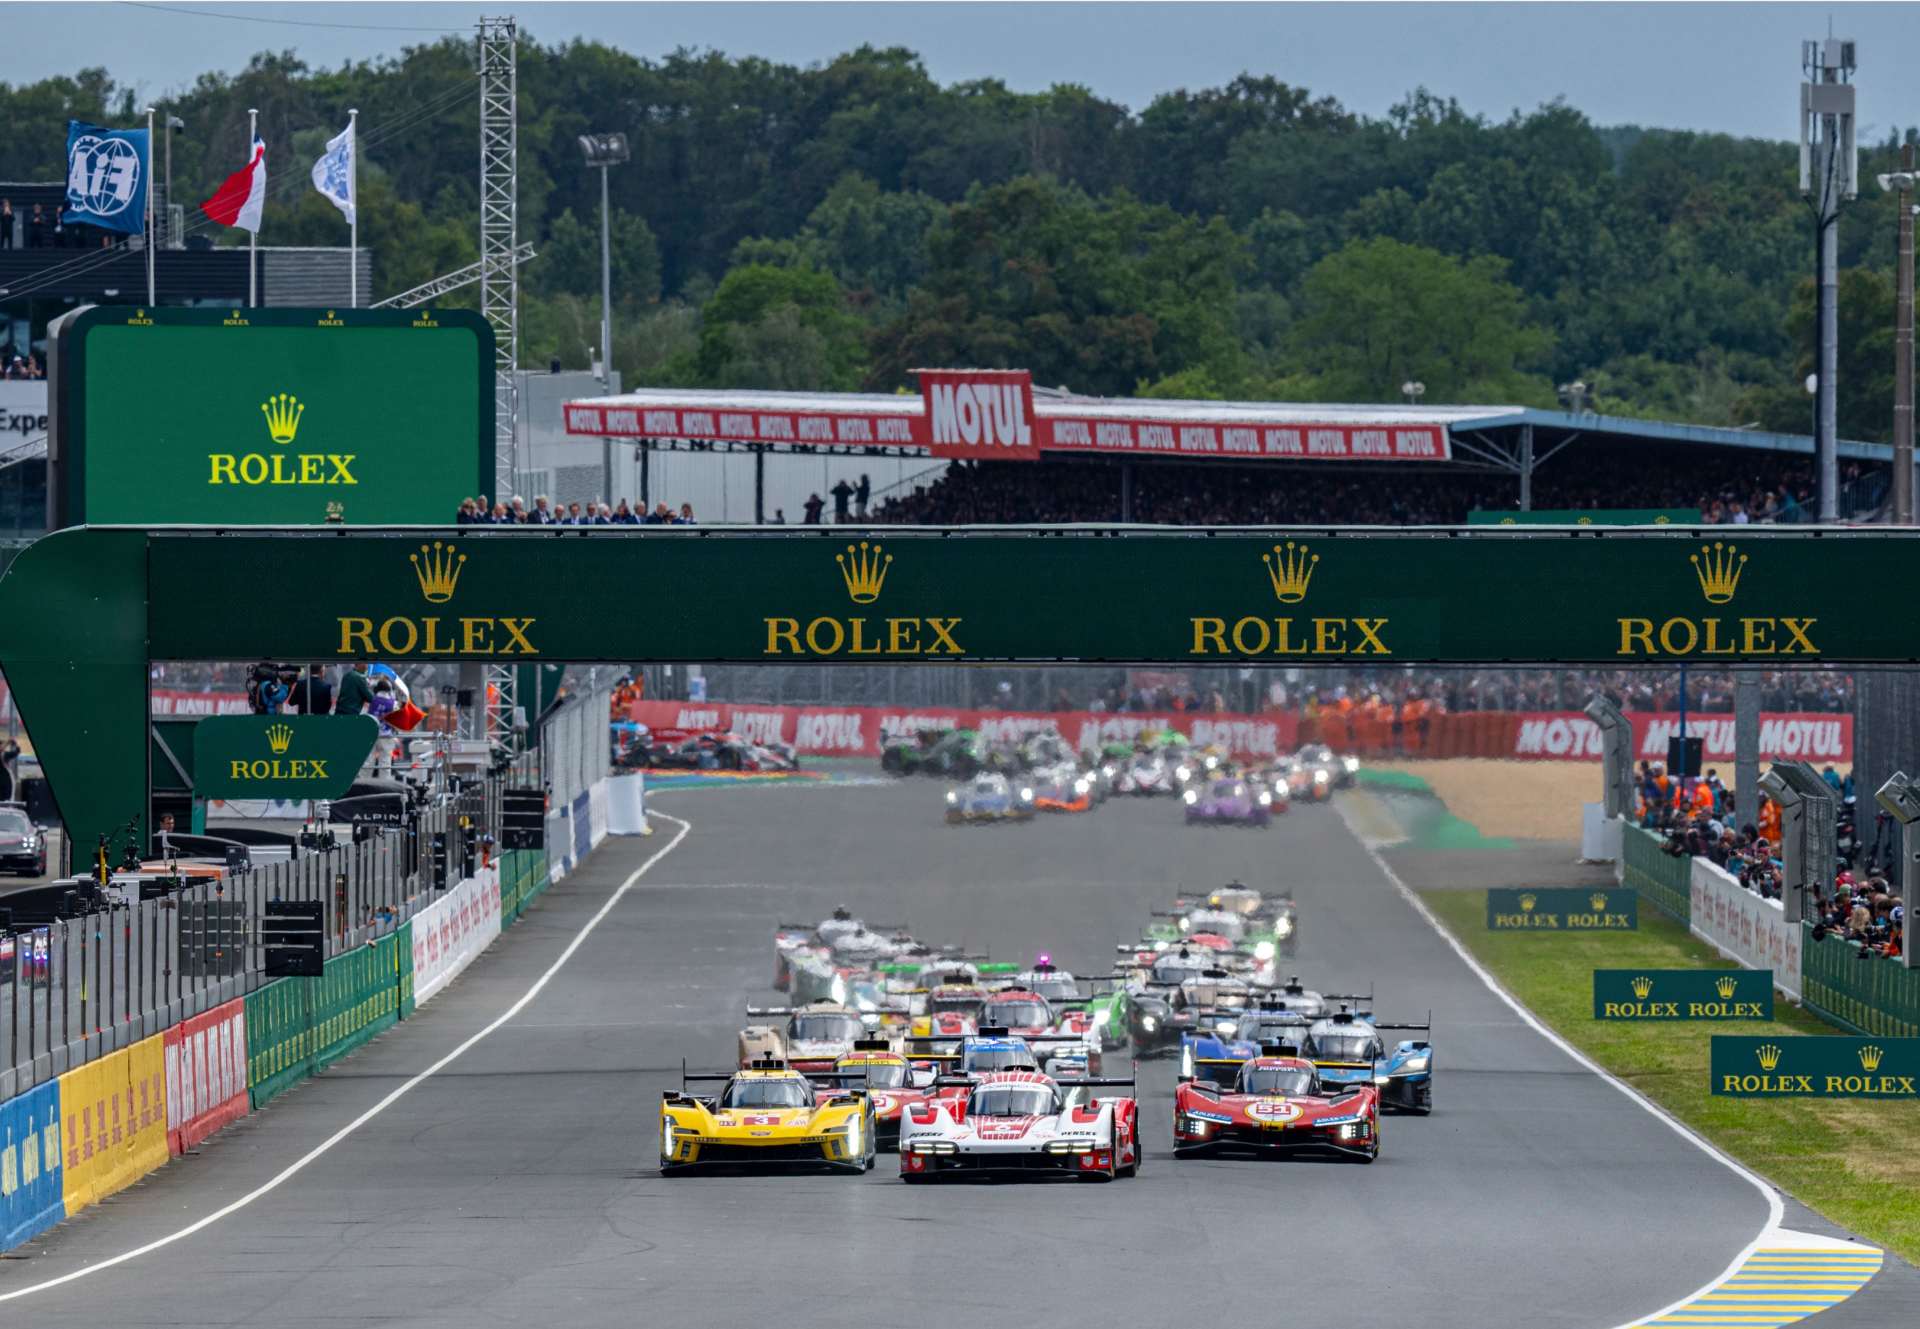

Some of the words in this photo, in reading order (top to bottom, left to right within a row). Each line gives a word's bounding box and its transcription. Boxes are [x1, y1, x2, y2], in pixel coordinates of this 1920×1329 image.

[127, 317, 153, 326] ROLEX
[223, 318, 249, 327] ROLEX
[318, 319, 344, 327] ROLEX
[413, 320, 438, 328] ROLEX
[569, 408, 602, 432] MOTUL
[606, 409, 641, 433] MOTUL
[643, 410, 679, 434] MOTUL
[682, 411, 716, 435] MOTUL
[719, 412, 755, 436] MOTUL
[759, 414, 794, 439] MOTUL
[798, 416, 833, 440] MOTUL
[837, 417, 873, 441] MOTUL
[876, 418, 913, 442] MOTUL
[931, 383, 1032, 447] MOTUL
[1053, 420, 1092, 446] MOTUL
[1095, 422, 1134, 448] MOTUL
[1137, 424, 1175, 449] MOTUL
[1179, 426, 1218, 451] MOTUL
[1222, 428, 1260, 452] MOTUL
[1264, 429, 1303, 454] MOTUL
[1307, 430, 1347, 454] MOTUL
[1351, 430, 1392, 455] MOTUL
[1395, 431, 1436, 455] MOTUL
[208, 453, 358, 485] ROLEX
[336, 616, 539, 655] ROLEX
[763, 616, 965, 655] ROLEX
[1189, 616, 1391, 655] ROLEX
[1616, 616, 1821, 655] ROLEX
[795, 713, 865, 749] MOTUL
[1515, 718, 1604, 755] MOTU
[1759, 719, 1842, 756] MOTUL
[229, 759, 329, 780] ROLEX
[1495, 914, 1558, 928] ROLEX
[1567, 914, 1629, 928] ROLEX
[1604, 1002, 1679, 1017] ROLEX
[1689, 1002, 1763, 1017] ROLEX
[1722, 1074, 1814, 1092] ROLEX
[1825, 1075, 1917, 1093] ROLEX
[752, 1115, 769, 1126] 3
[1258, 1104, 1290, 1114] 51
